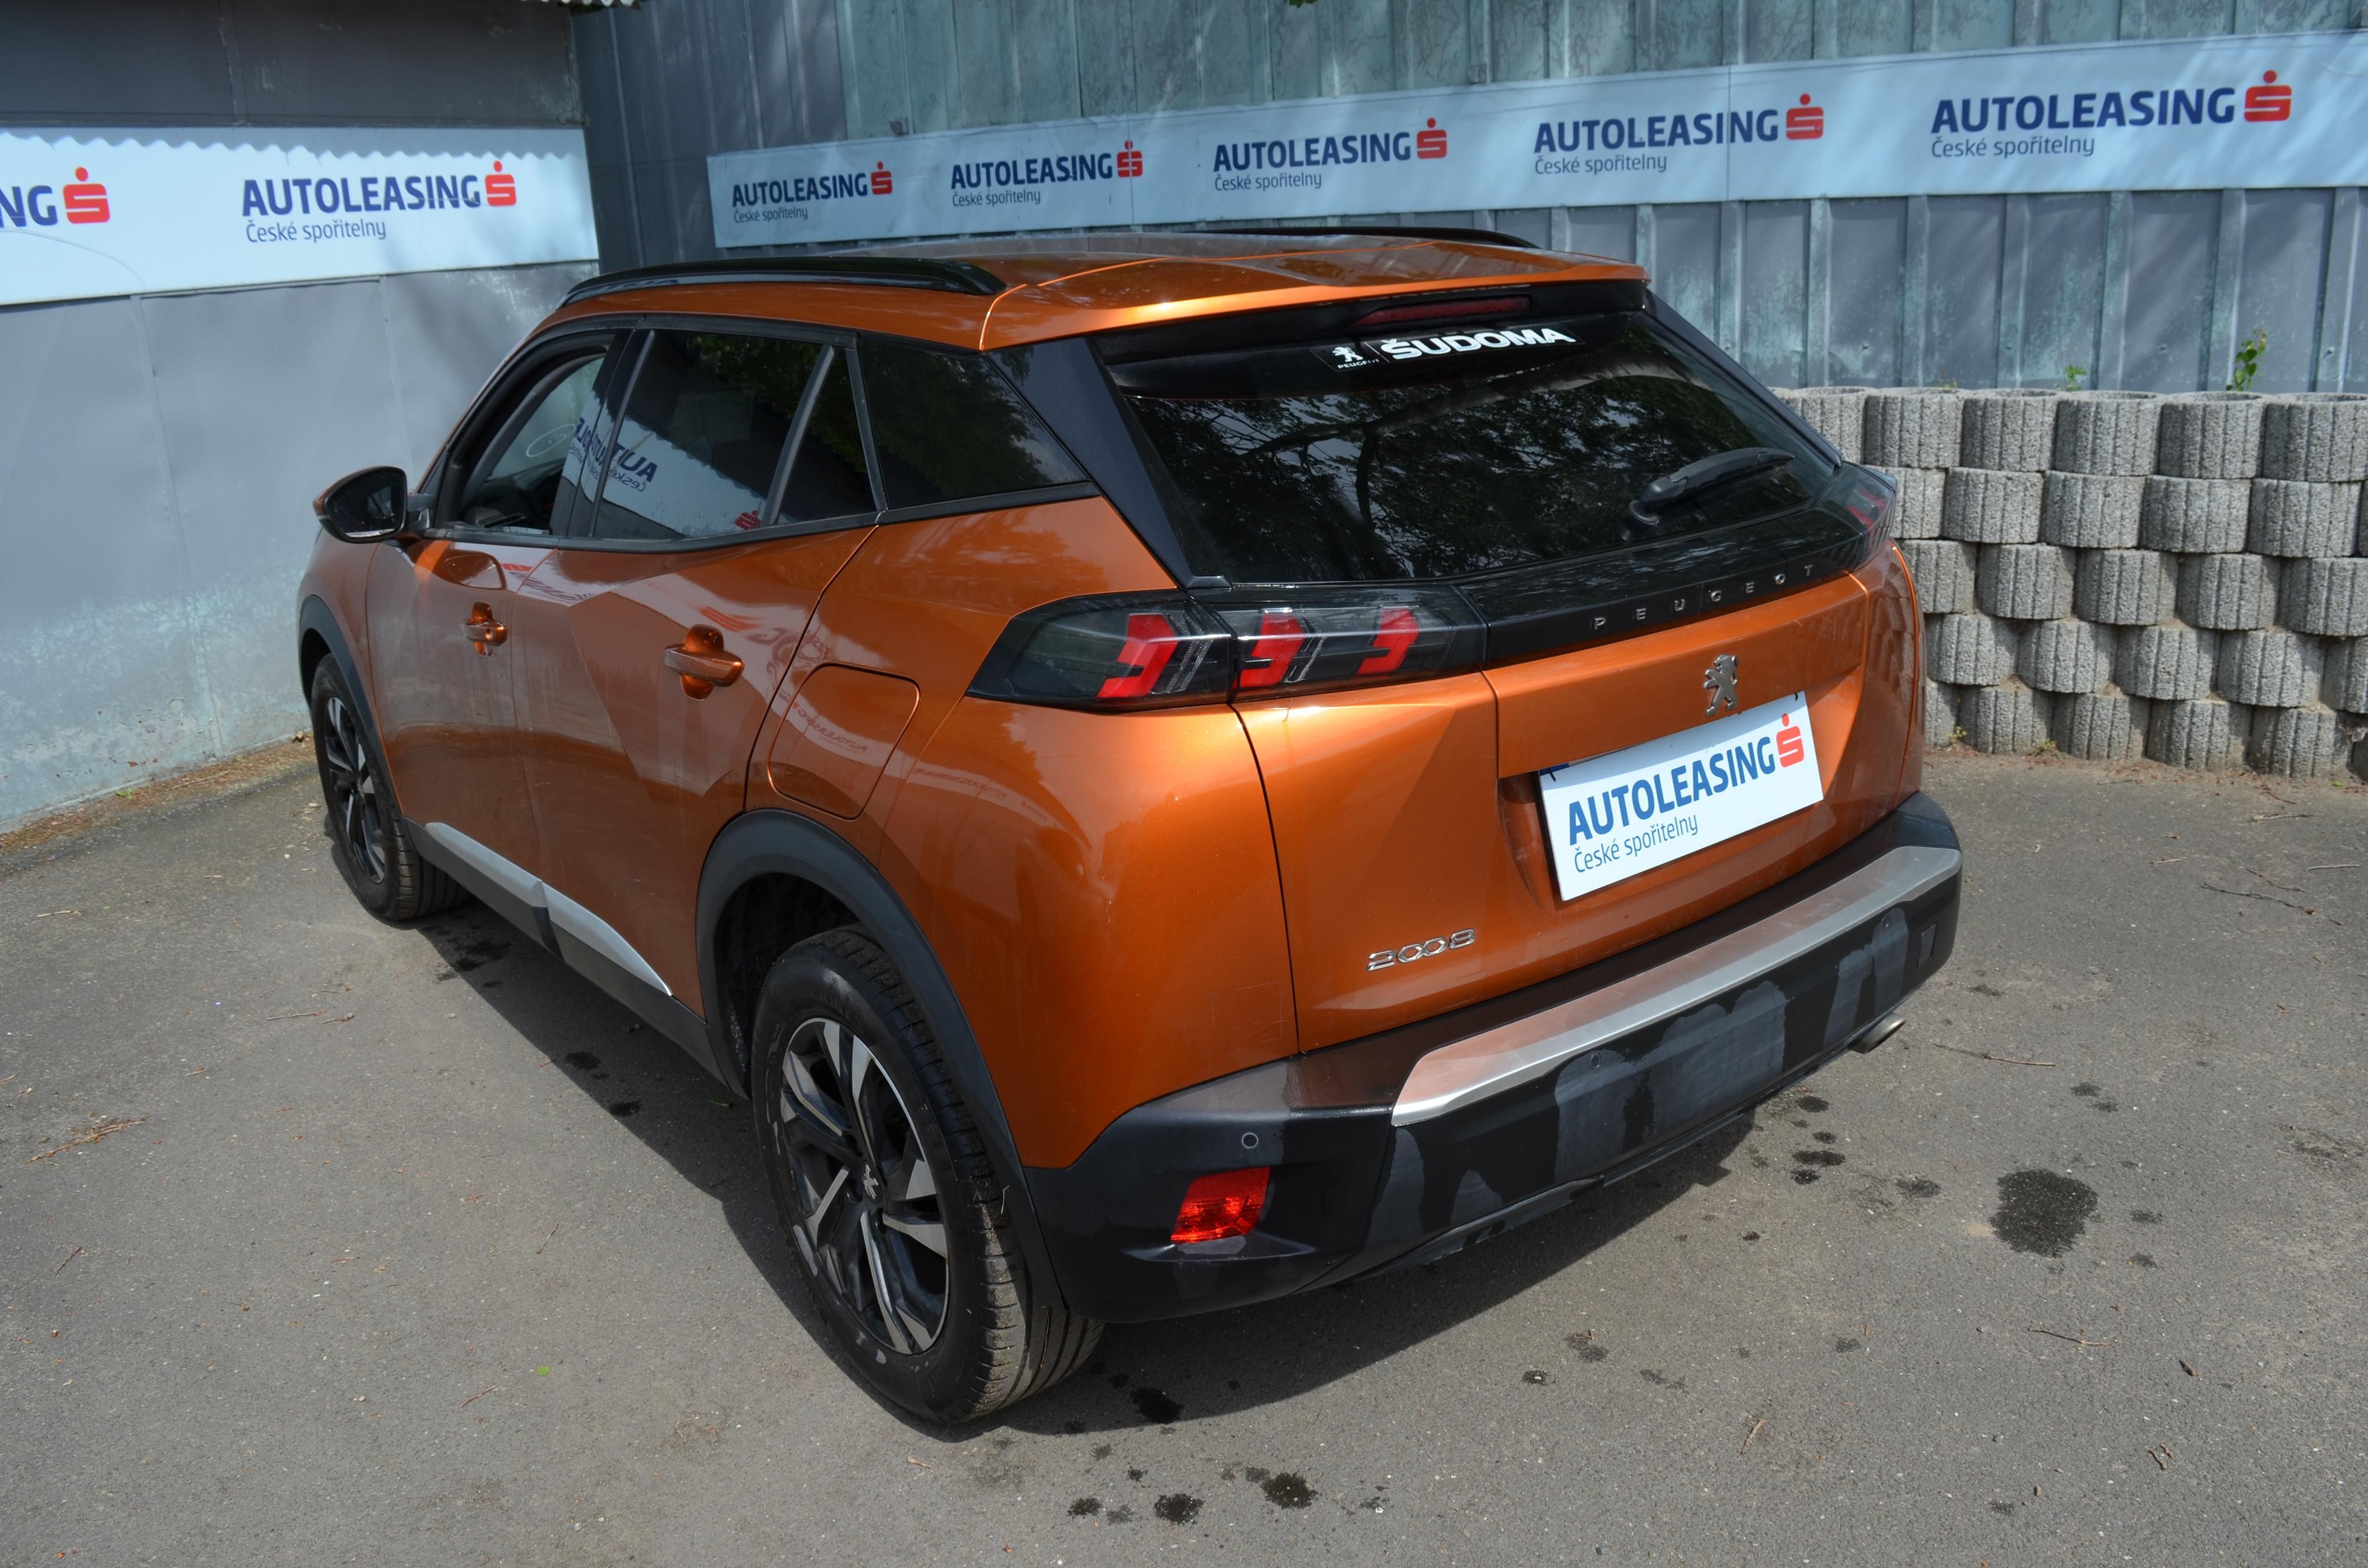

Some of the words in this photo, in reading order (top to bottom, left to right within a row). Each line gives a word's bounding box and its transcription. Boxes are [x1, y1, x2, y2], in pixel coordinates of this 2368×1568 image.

[1930, 87, 2235, 134] AUTOLEASING
[1534, 109, 1778, 153] AUTOLEASING
[1932, 135, 1986, 157] České
[1993, 135, 2094, 159] spořitelny
[1213, 132, 1410, 172] AUTOLEASING
[1535, 154, 1579, 175] České
[1585, 153, 1667, 175] spořitelny
[732, 173, 867, 207] AUTOLEASING
[951, 153, 1112, 190] AUTOLEASING
[1214, 173, 1251, 191] České
[1255, 172, 1322, 191] spořitelny
[242, 175, 480, 217] AUTOLEASING
[734, 206, 759, 223] České
[762, 205, 808, 222] spořitelny
[953, 190, 982, 206] České
[986, 188, 1040, 206] spořitelny
[246, 218, 297, 243] České
[302, 218, 386, 243] spořitelny
[1381, 328, 1577, 359] ŠUDOMA
[1593, 565, 1814, 631] PEUGEOT
[1569, 736, 1776, 846] AUTOLEASING
[1574, 839, 1620, 873] České
[1625, 814, 1699, 857] spořitelny
[1366, 928, 1475, 972] 2008
